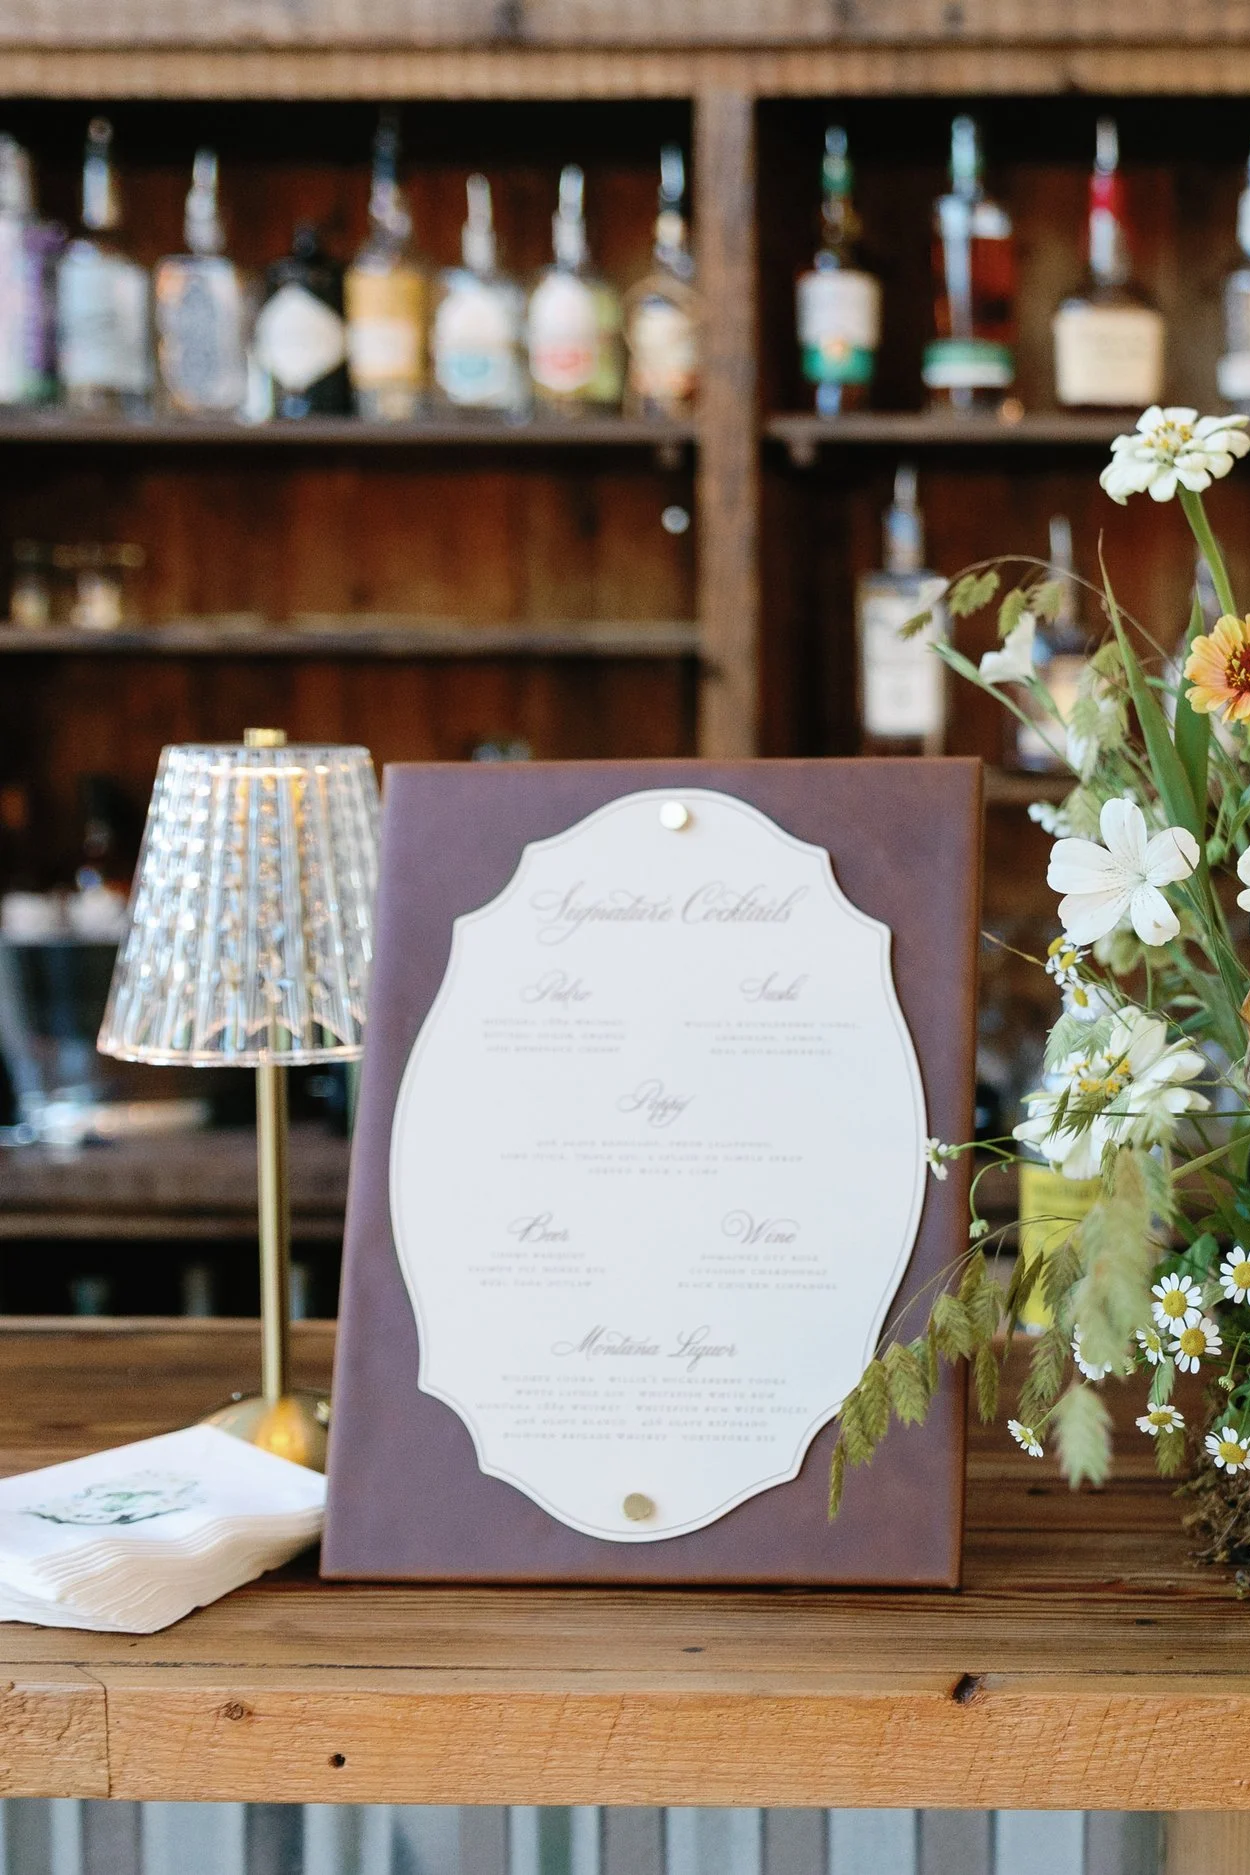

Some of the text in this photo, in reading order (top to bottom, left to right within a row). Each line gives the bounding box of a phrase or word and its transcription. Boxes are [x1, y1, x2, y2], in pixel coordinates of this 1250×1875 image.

[680, 880, 811, 925] Cocktails
[720, 1209, 801, 1246] Wine
[550, 1324, 739, 1373] Montana Liquor
